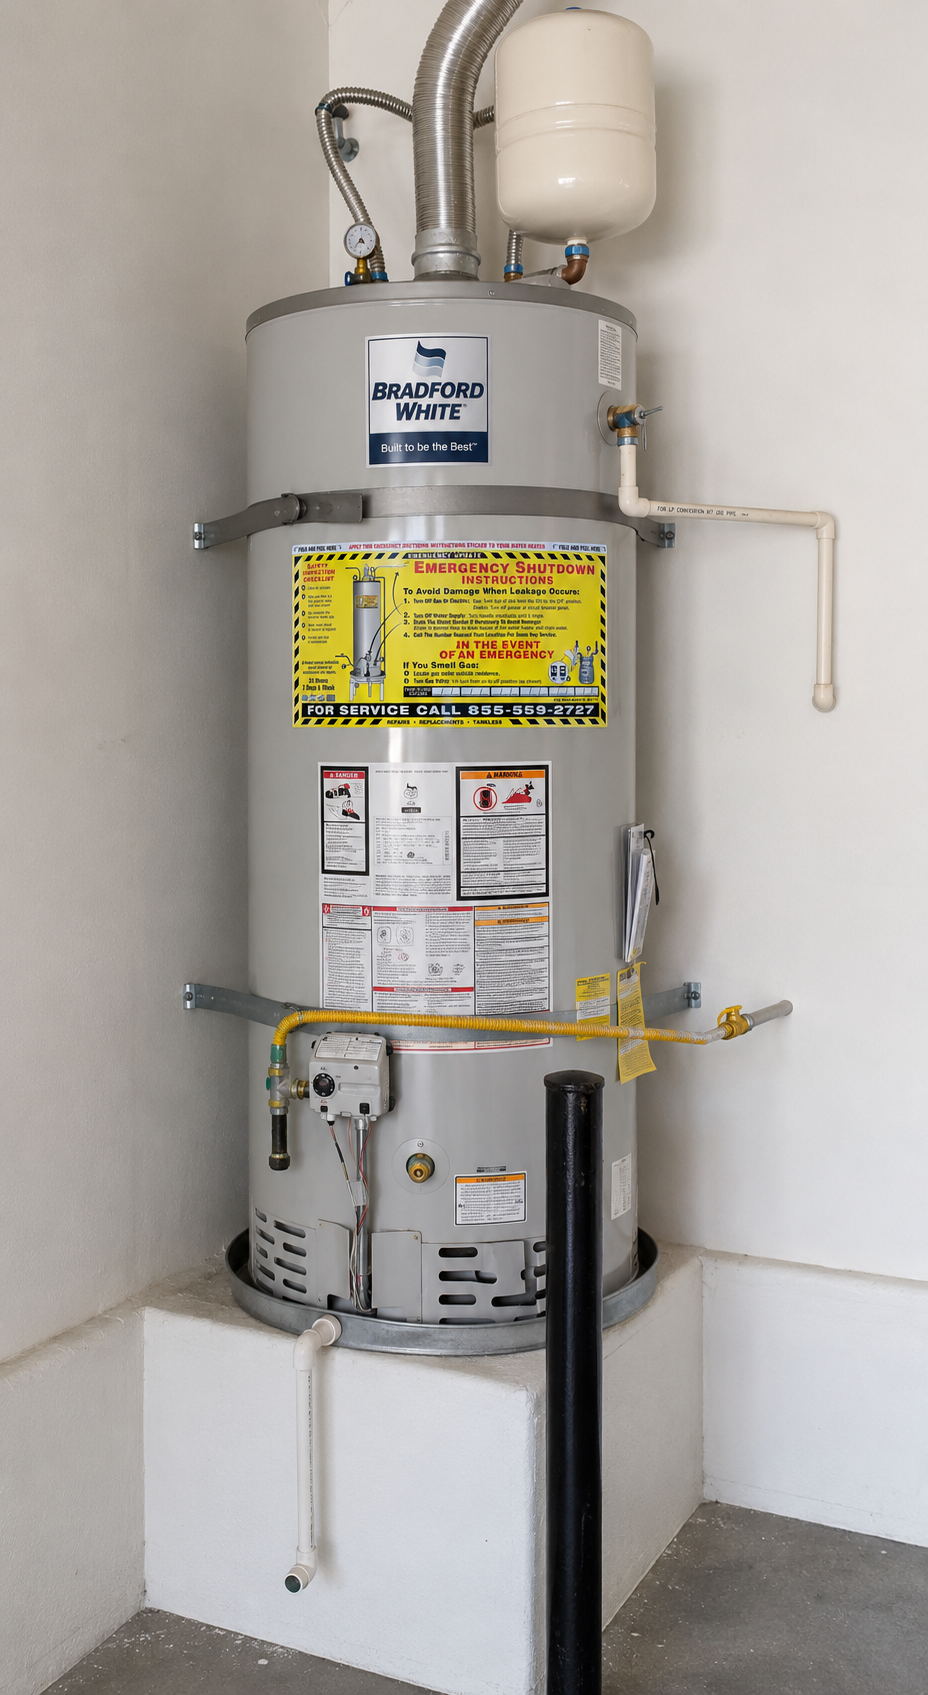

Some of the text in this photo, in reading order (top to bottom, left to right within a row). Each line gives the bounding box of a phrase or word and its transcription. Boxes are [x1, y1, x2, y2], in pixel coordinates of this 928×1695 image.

[372, 382, 485, 401] BRADFORD
[381, 443, 402, 453] Built
[405, 443, 415, 452] to
[417, 442, 430, 452] be
[432, 442, 448, 452] the
[414, 560, 595, 575] EMERGENCY SHUTDOWN
[461, 575, 554, 585] INSTRUCTIONS
[403, 587, 413, 595] To
[416, 587, 441, 595] Avoid
[443, 587, 480, 597] Damage
[482, 586, 508, 595] When
[510, 586, 547, 597] Leakage
[403, 611, 410, 619] 2.
[456, 640, 541, 650] IN THE EVENT
[439, 650, 555, 660] OF AN EMERGENCY
[403, 661, 410, 669] If
[412, 661, 428, 669] You
[431, 661, 456, 669] Smell
[307, 704, 595, 716] FOR SERVICE CALL 855-559-2727
